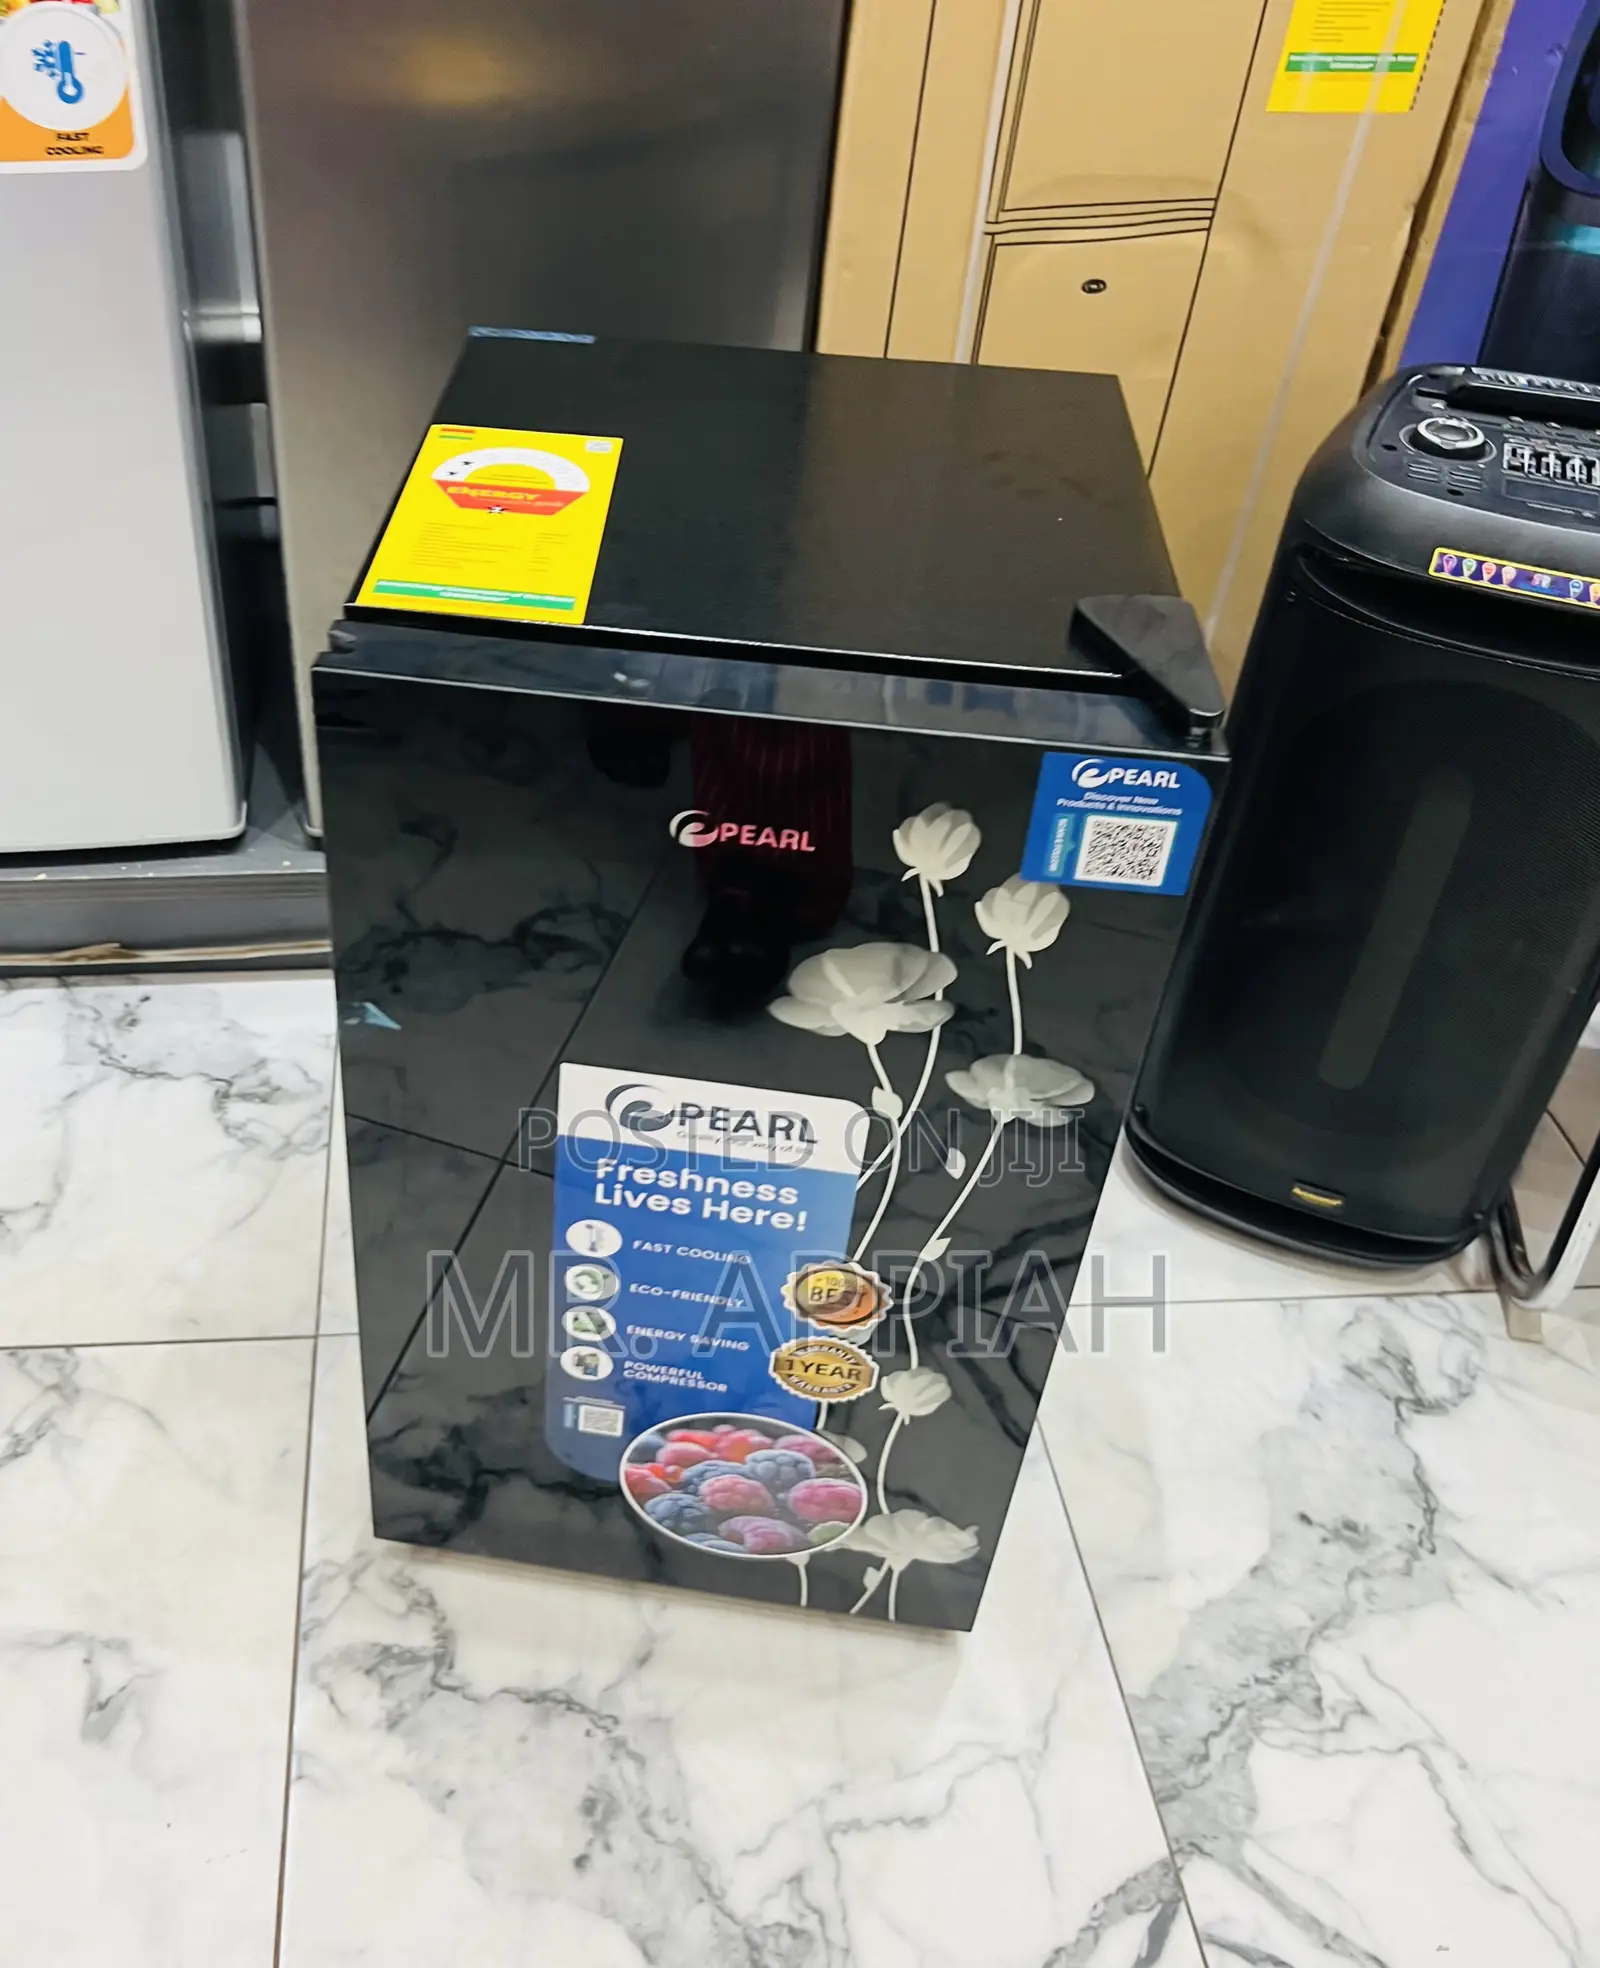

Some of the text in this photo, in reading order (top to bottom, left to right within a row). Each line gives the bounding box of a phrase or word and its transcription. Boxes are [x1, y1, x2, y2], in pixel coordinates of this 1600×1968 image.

[1107, 767, 1181, 789] PEARL
[719, 822, 816, 852] PEARL
[678, 1101, 819, 1145] PEARL
[595, 1158, 799, 1205] Freshness
[594, 1183, 808, 1232] Lives Here!
[633, 1240, 751, 1265] FAST COOLING
[629, 1283, 745, 1309] ECO-FRIENDLY
[626, 1325, 750, 1351] ENERGY SAVING
[622, 1370, 728, 1393] COMPRESSOR
[623, 1360, 705, 1380] POWERFUL
[800, 1360, 861, 1382] YEAR
